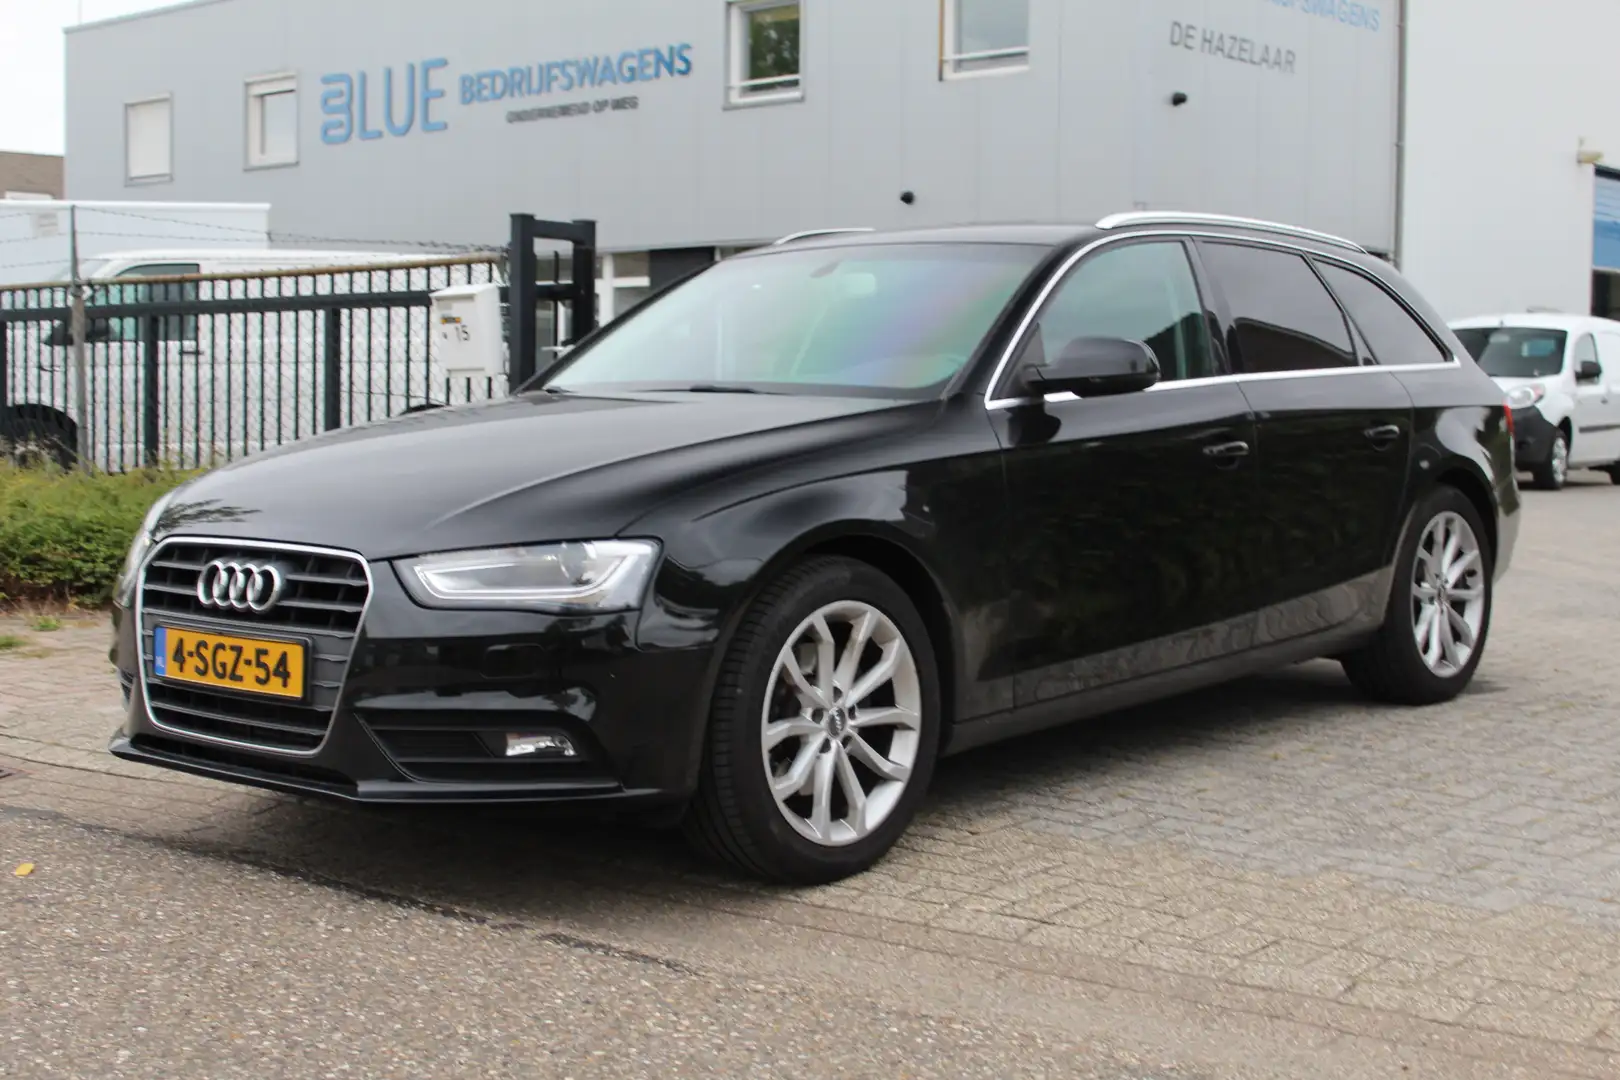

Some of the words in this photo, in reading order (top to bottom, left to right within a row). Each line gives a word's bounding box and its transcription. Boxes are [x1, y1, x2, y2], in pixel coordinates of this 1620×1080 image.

[459, 43, 693, 105] BEDRIJFSWAGENS
[1169, 21, 1197, 50] DE
[1201, 28, 1296, 74] HAZELAAR
[172, 637, 291, 688] 4-SGZ-54
